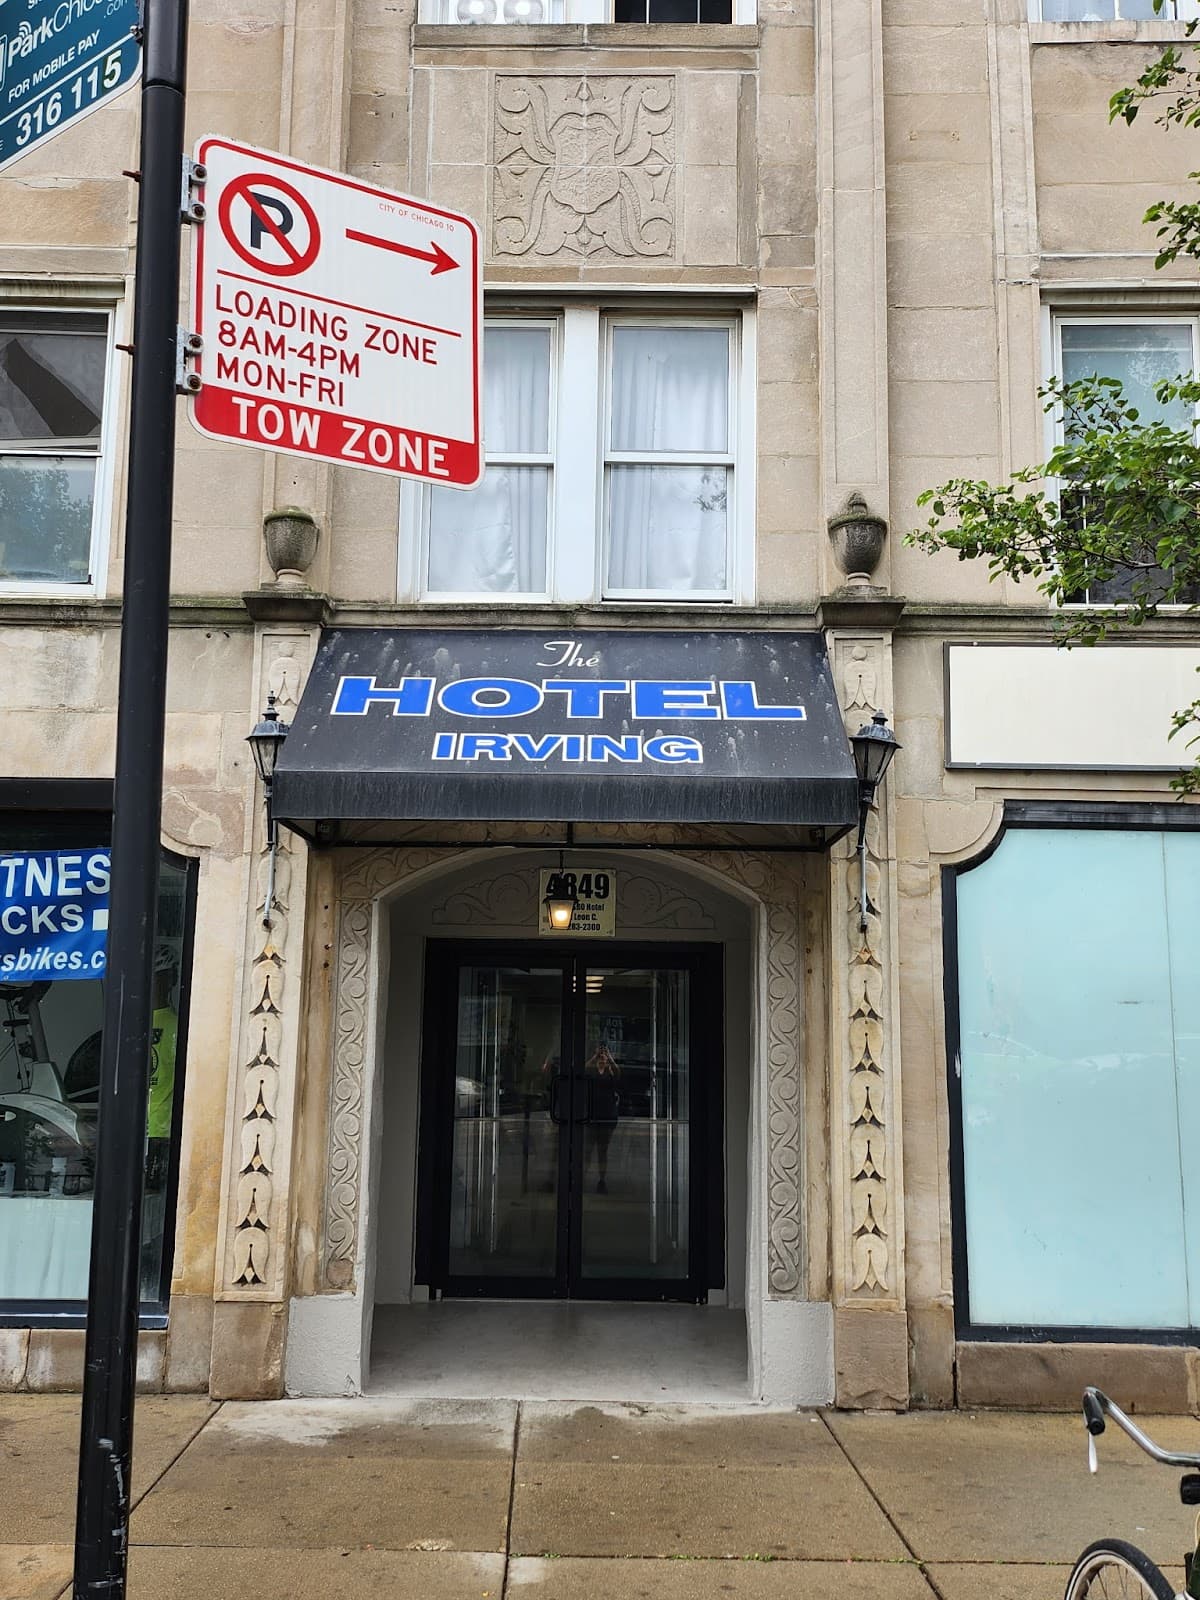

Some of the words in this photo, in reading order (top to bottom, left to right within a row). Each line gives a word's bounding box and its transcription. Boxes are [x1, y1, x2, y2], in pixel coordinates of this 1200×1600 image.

[9, 79, 30, 103] FOR
[33, 47, 75, 87] MOBILE
[78, 29, 100, 56] PAY
[16, 92, 62, 146] 316
[71, 50, 122, 110] 115
[379, 203, 396, 213] CITY
[411, 213, 444, 229] CHICAGO
[215, 283, 348, 341] LOADING
[364, 323, 437, 365] ZONE
[218, 320, 360, 378] 8AM-4PM
[216, 353, 344, 407] MON-FRI
[232, 396, 321, 449] TOW
[341, 421, 450, 476] ZONE
[536, 640, 600, 668] The
[330, 675, 807, 721] HOTEL
[431, 732, 704, 763] IRVING
[1, 904, 84, 935] CKS
